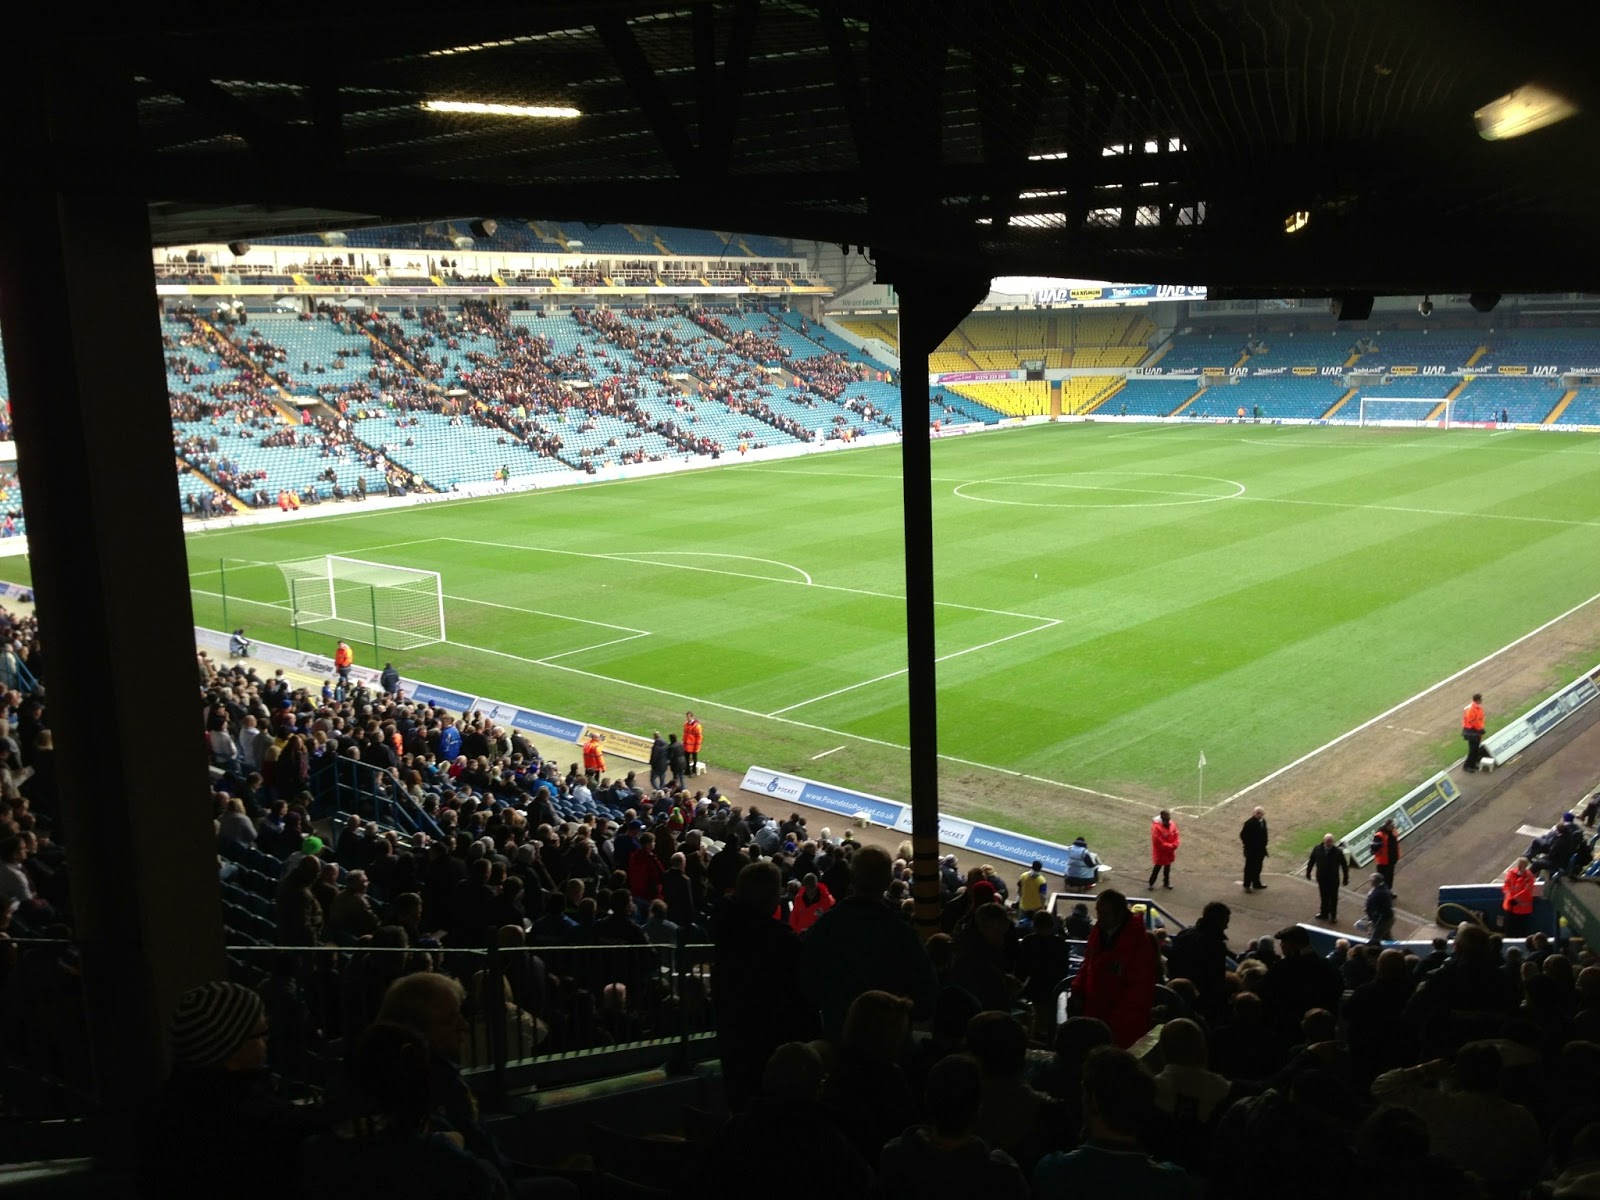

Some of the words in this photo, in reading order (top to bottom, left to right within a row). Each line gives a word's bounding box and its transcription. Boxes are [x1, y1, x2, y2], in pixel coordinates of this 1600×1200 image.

[862, 298, 882, 306] Leeds!
[617, 736, 629, 744] Leeds
[629, 739, 644, 747] United
[746, 778, 767, 788] POUNDS
[777, 786, 798, 795] POCKET
[805, 792, 895, 820] www.PoundstoPocket.co.uk
[940, 829, 965, 840] POCKET
